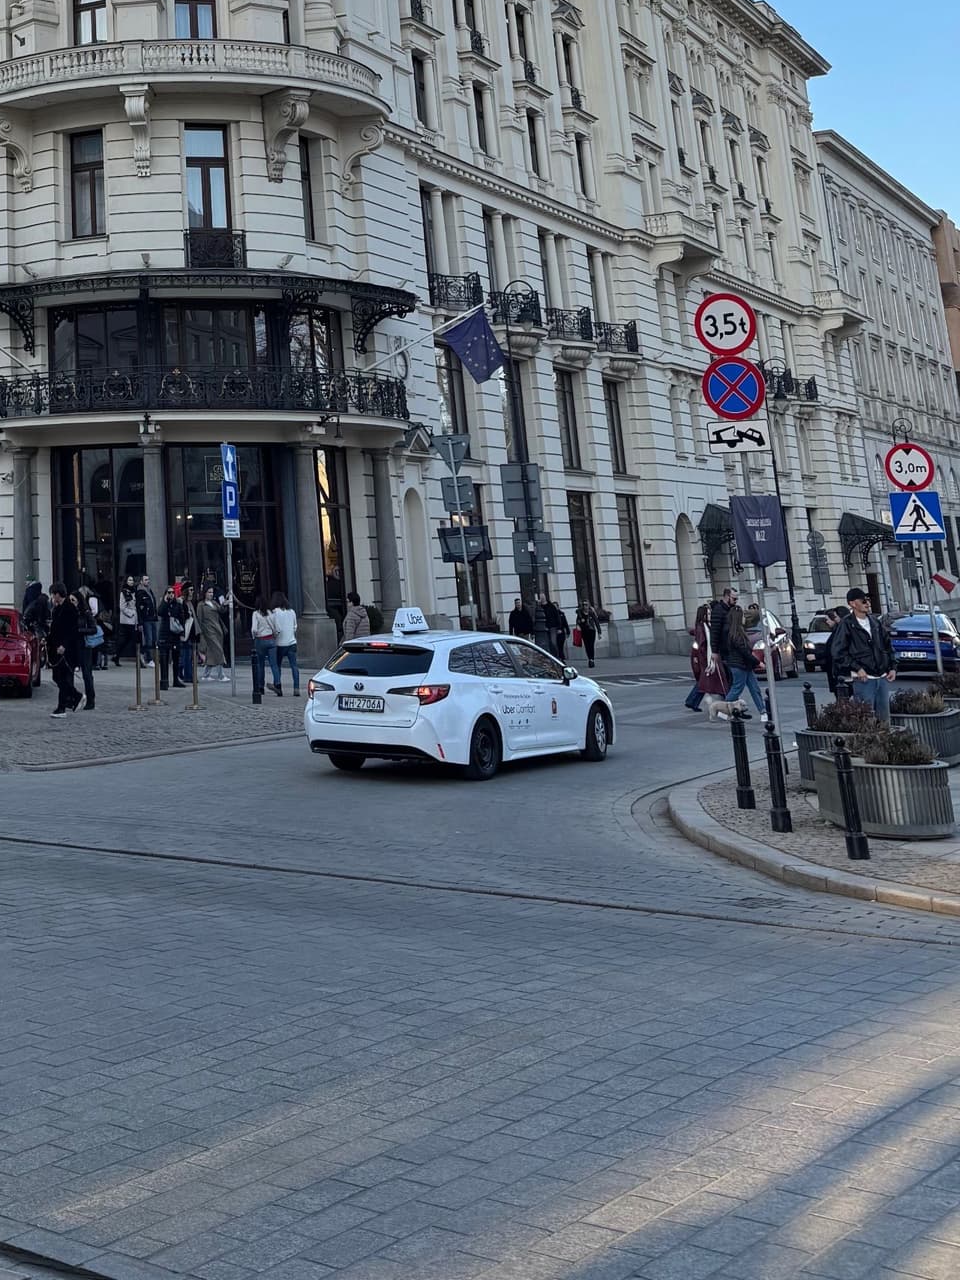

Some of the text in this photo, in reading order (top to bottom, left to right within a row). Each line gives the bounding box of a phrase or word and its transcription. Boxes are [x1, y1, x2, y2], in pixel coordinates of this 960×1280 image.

[704, 312, 748, 340] 3,5t
[894, 460, 927, 475] 3,0m
[226, 485, 236, 515] P
[406, 613, 423, 625] Uber
[343, 697, 381, 709] WH 2706A
[502, 704, 515, 714] Uber
